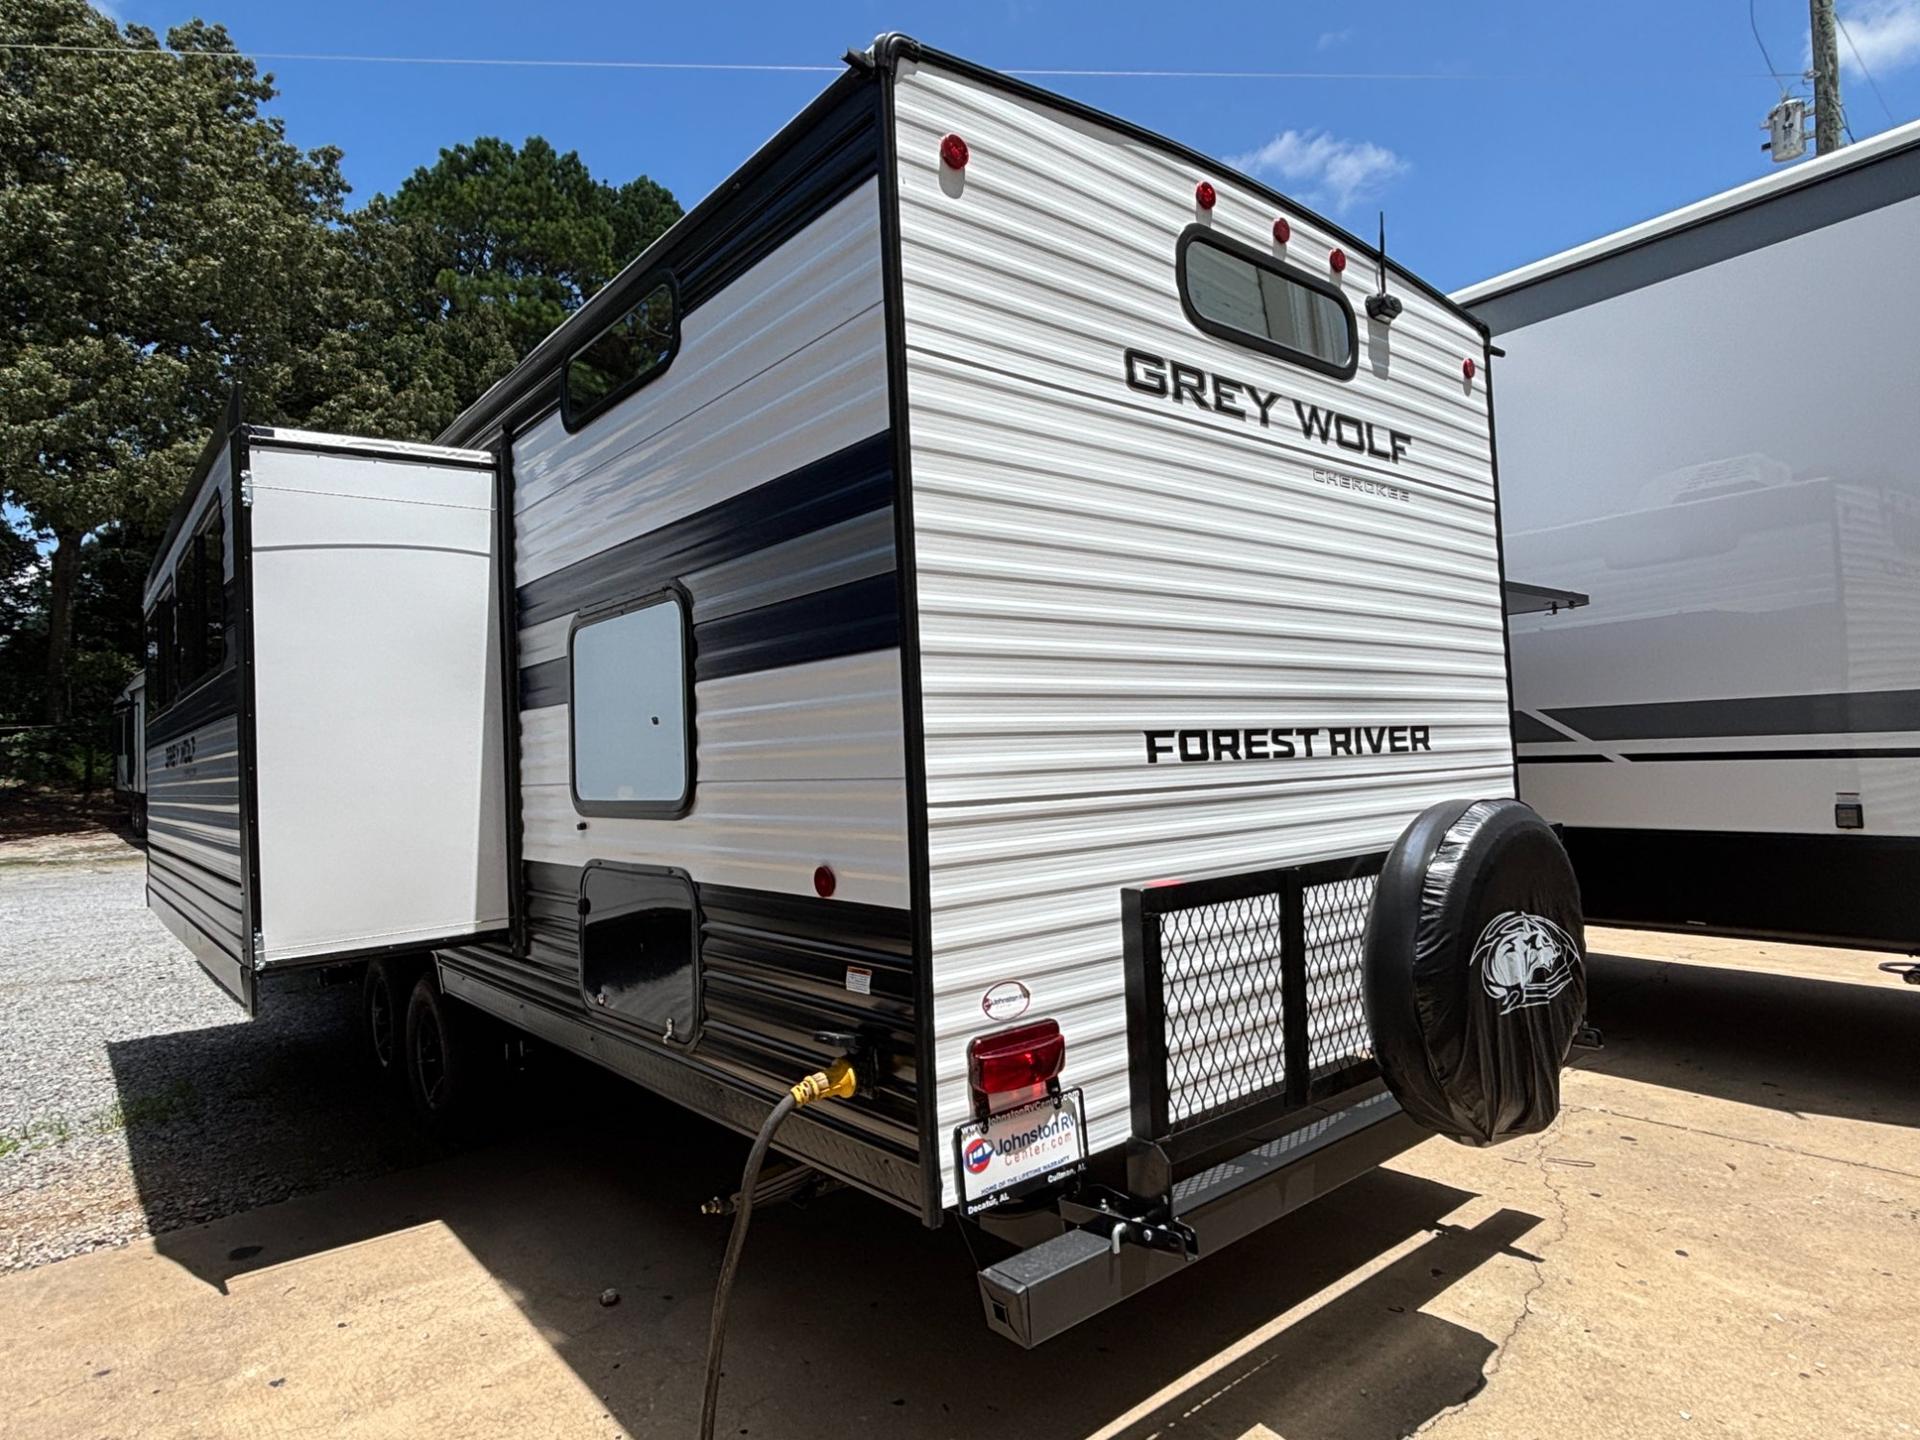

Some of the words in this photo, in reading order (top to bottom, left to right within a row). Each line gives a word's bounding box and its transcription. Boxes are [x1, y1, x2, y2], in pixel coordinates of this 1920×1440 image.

[1124, 347, 1281, 428] GREY
[1291, 399, 1412, 464] WOLF
[1312, 468, 1410, 502] CHEROKEE
[1143, 728, 1319, 763] FOREST
[1327, 725, 1431, 757] RIVER
[995, 1121, 1059, 1156] Johnston
[1004, 1132, 1073, 1167] Center.com
[999, 1192, 1010, 1203] AL
